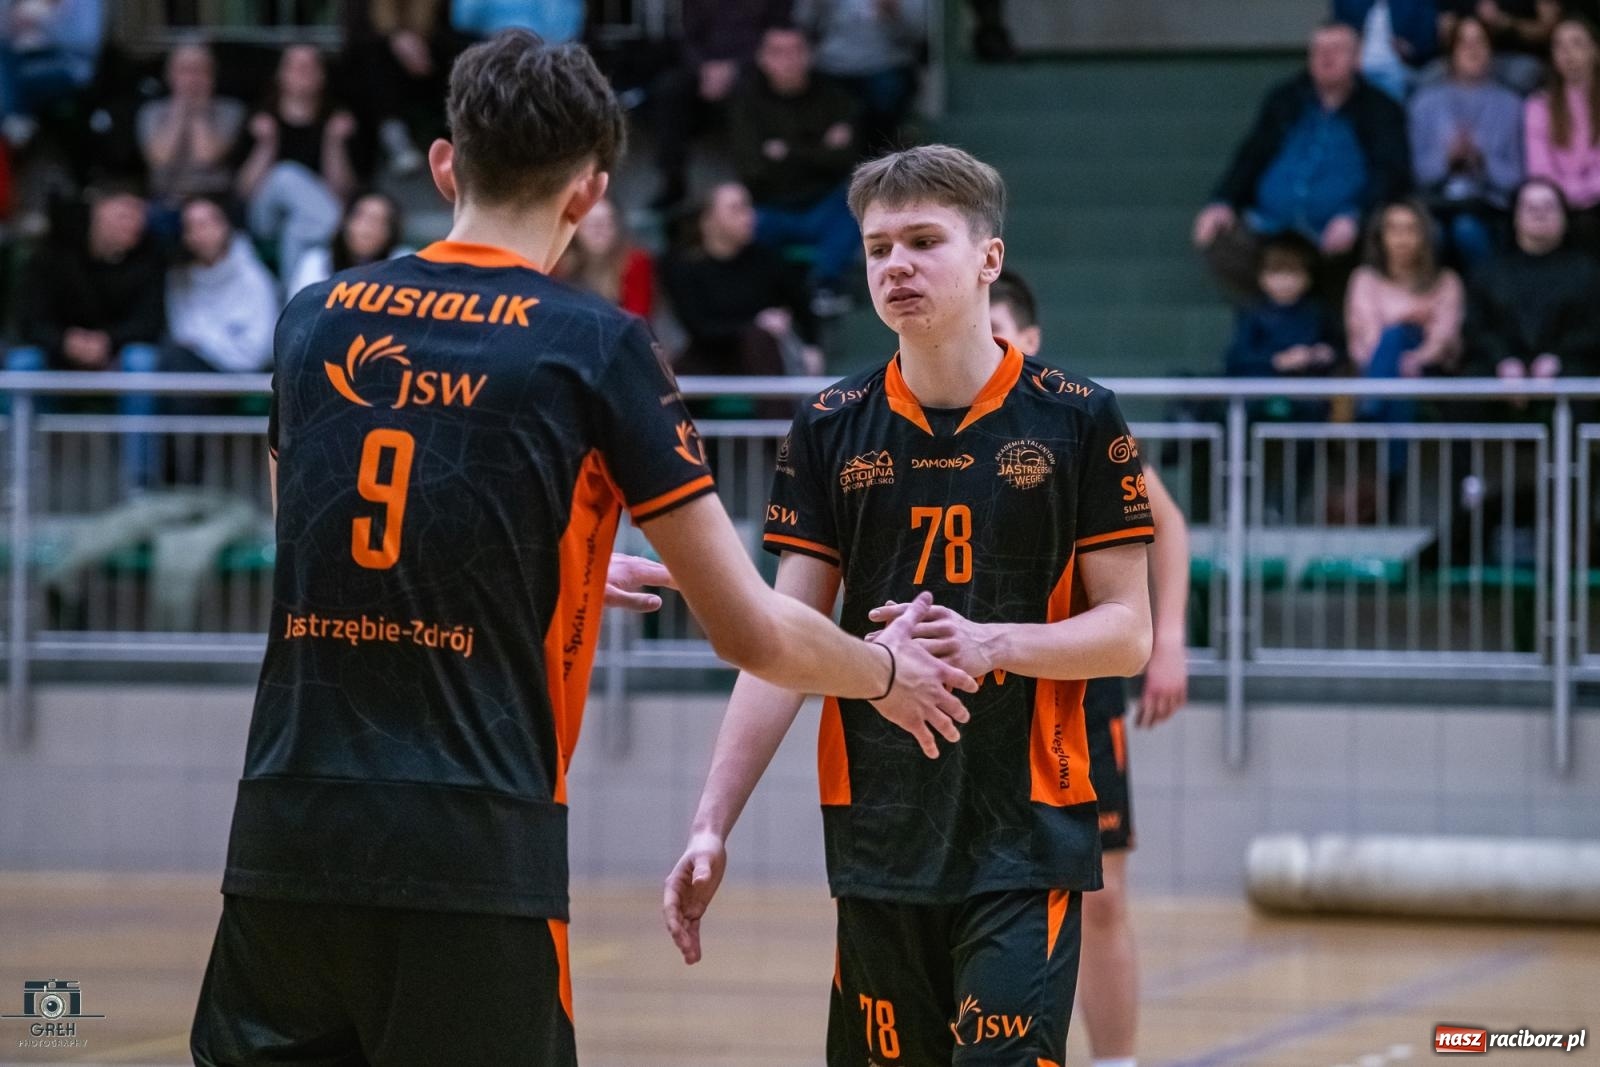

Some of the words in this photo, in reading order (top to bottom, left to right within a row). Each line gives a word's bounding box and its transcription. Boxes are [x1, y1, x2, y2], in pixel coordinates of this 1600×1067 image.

[325, 281, 540, 327] MUSIOLIK
[391, 369, 488, 409] JSW
[351, 428, 415, 569] 9
[911, 504, 973, 585] 78
[284, 613, 475, 658] Jastrzębie-Zdrój
[859, 992, 900, 1059] 78
[973, 1014, 1033, 1044] JSW
